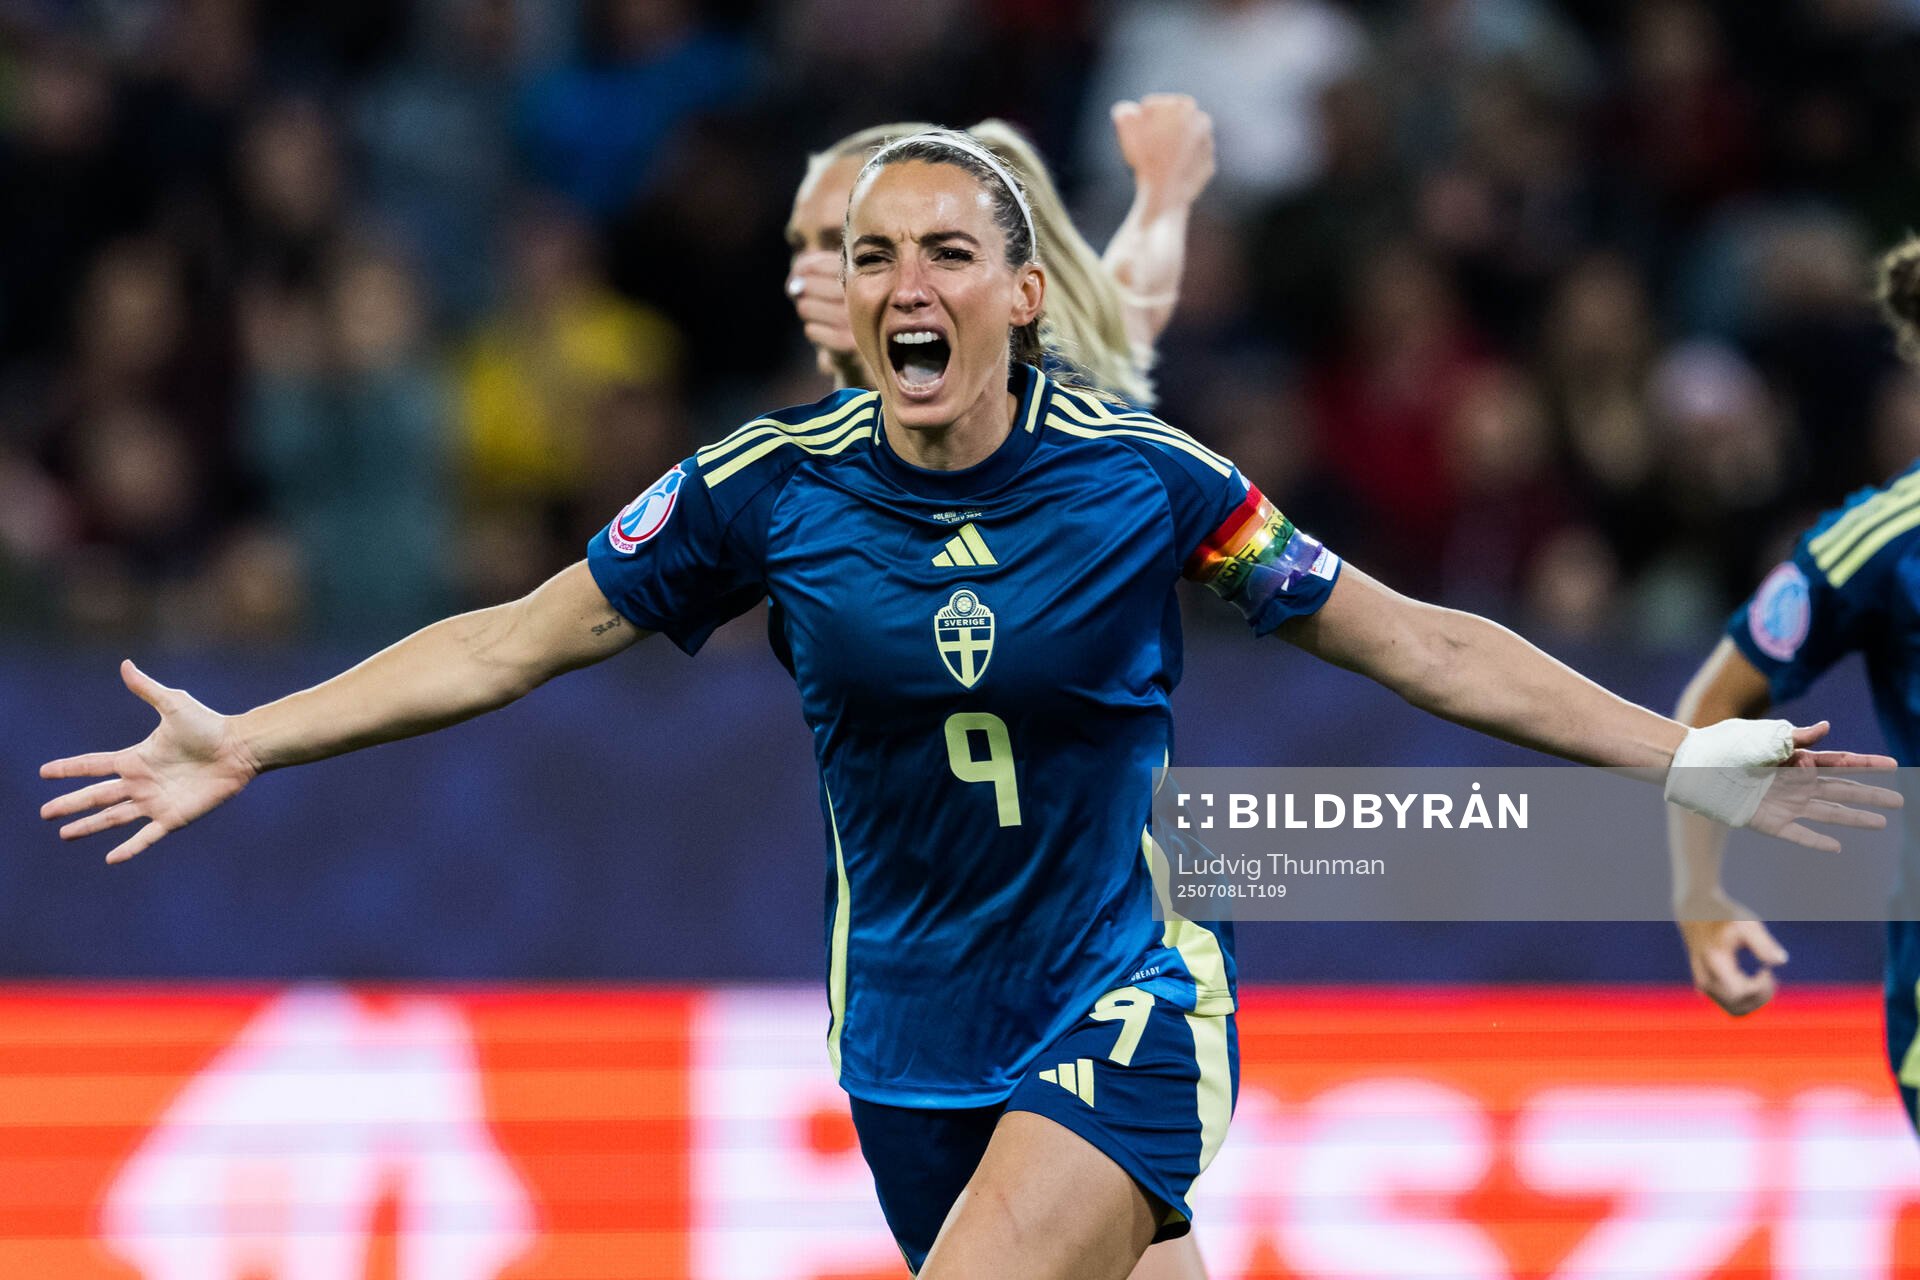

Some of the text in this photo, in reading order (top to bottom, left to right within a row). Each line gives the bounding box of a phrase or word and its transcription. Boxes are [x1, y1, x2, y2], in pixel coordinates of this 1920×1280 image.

[944, 618, 985, 627] SVERIGE
[944, 712, 1022, 828] 9
[1089, 986, 1155, 1066] 9
